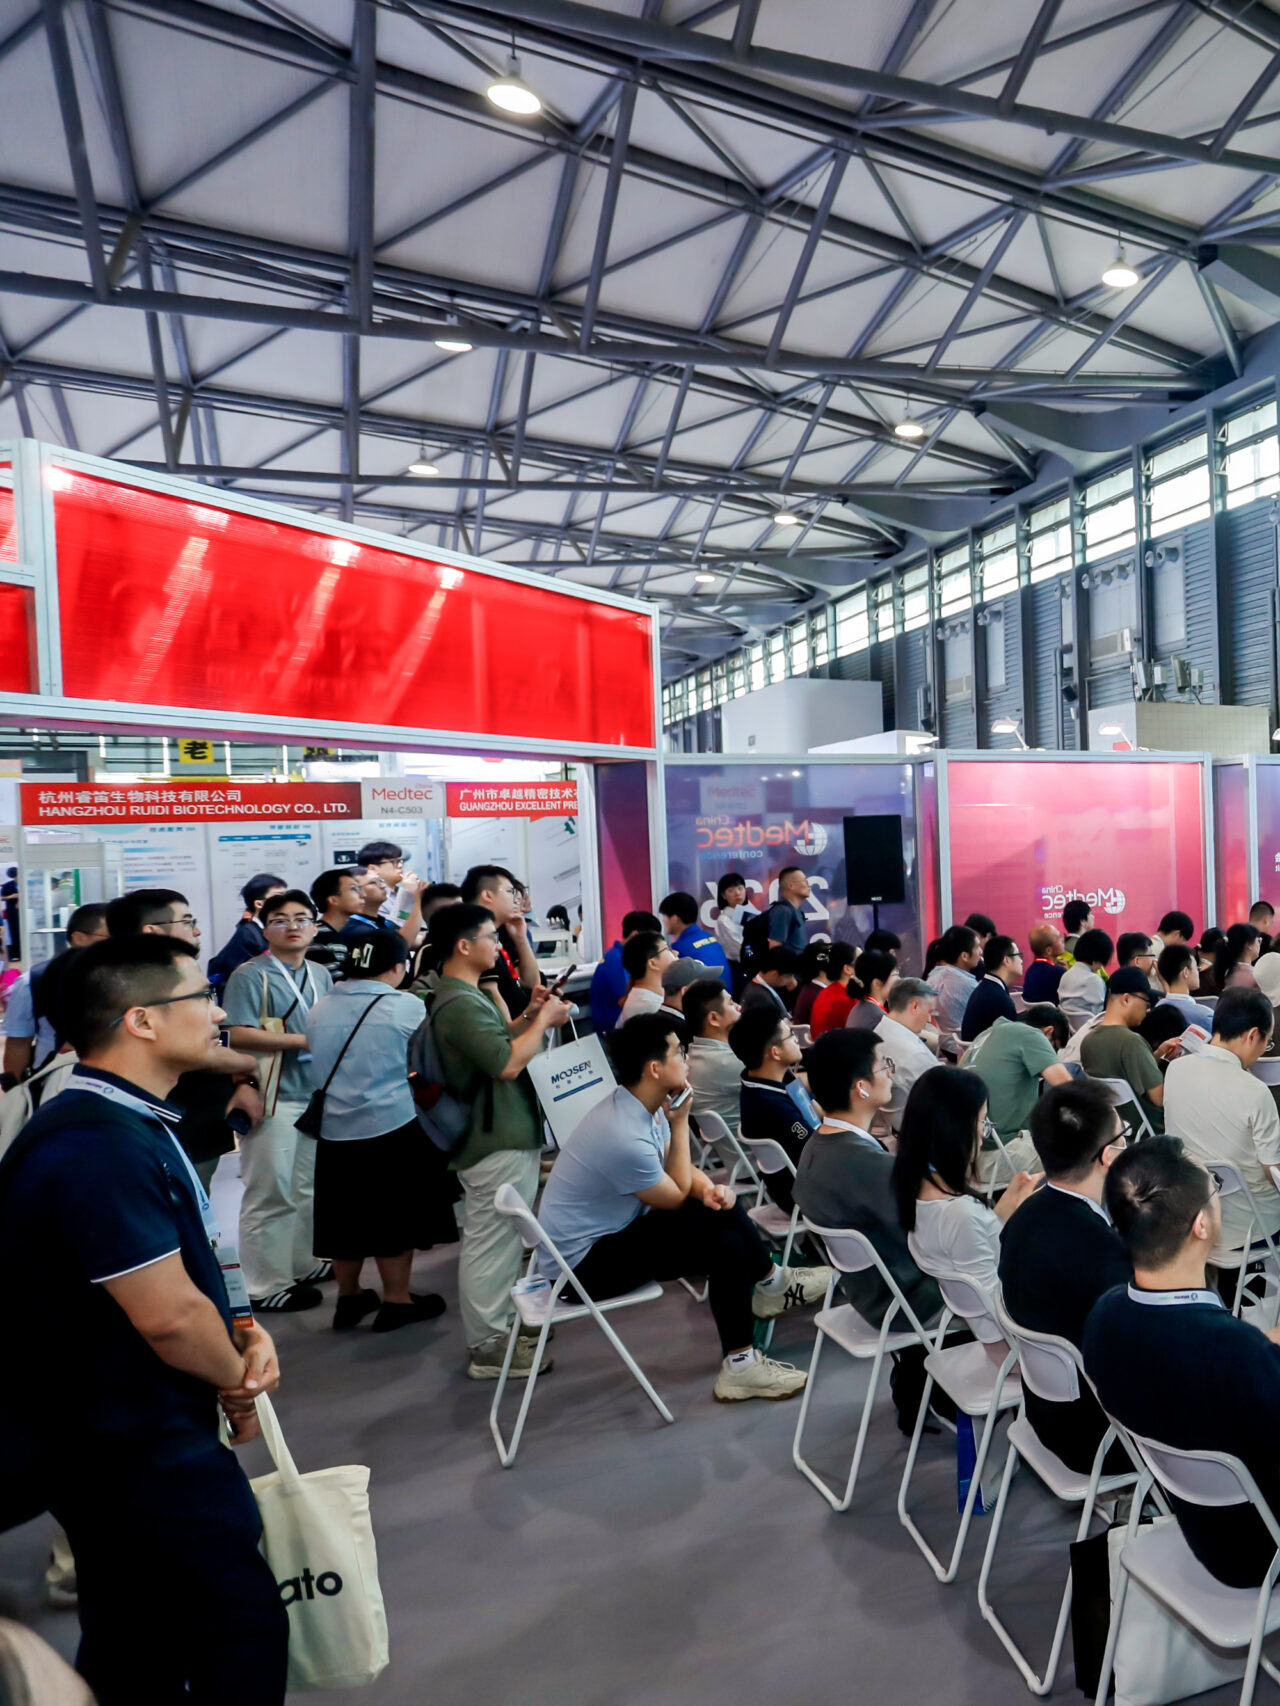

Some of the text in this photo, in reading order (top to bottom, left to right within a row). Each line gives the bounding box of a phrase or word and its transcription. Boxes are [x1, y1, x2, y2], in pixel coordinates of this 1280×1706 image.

[184, 740, 208, 760] 老
[39, 790, 241, 804] 杭州睿笛生物科技有限公司
[372, 787, 433, 800] Medtec
[39, 806, 126, 817] HANGZHOU
[130, 805, 169, 816] RUIDI
[173, 804, 291, 815] BIOTECHNOLOGY
[324, 802, 350, 813] LTD.
[381, 806, 423, 815] N4-C503
[459, 800, 514, 811] GUANGZHOU
[515, 801, 561, 811] EXCELLENT
[551, 1060, 592, 1084] MOOSEN
